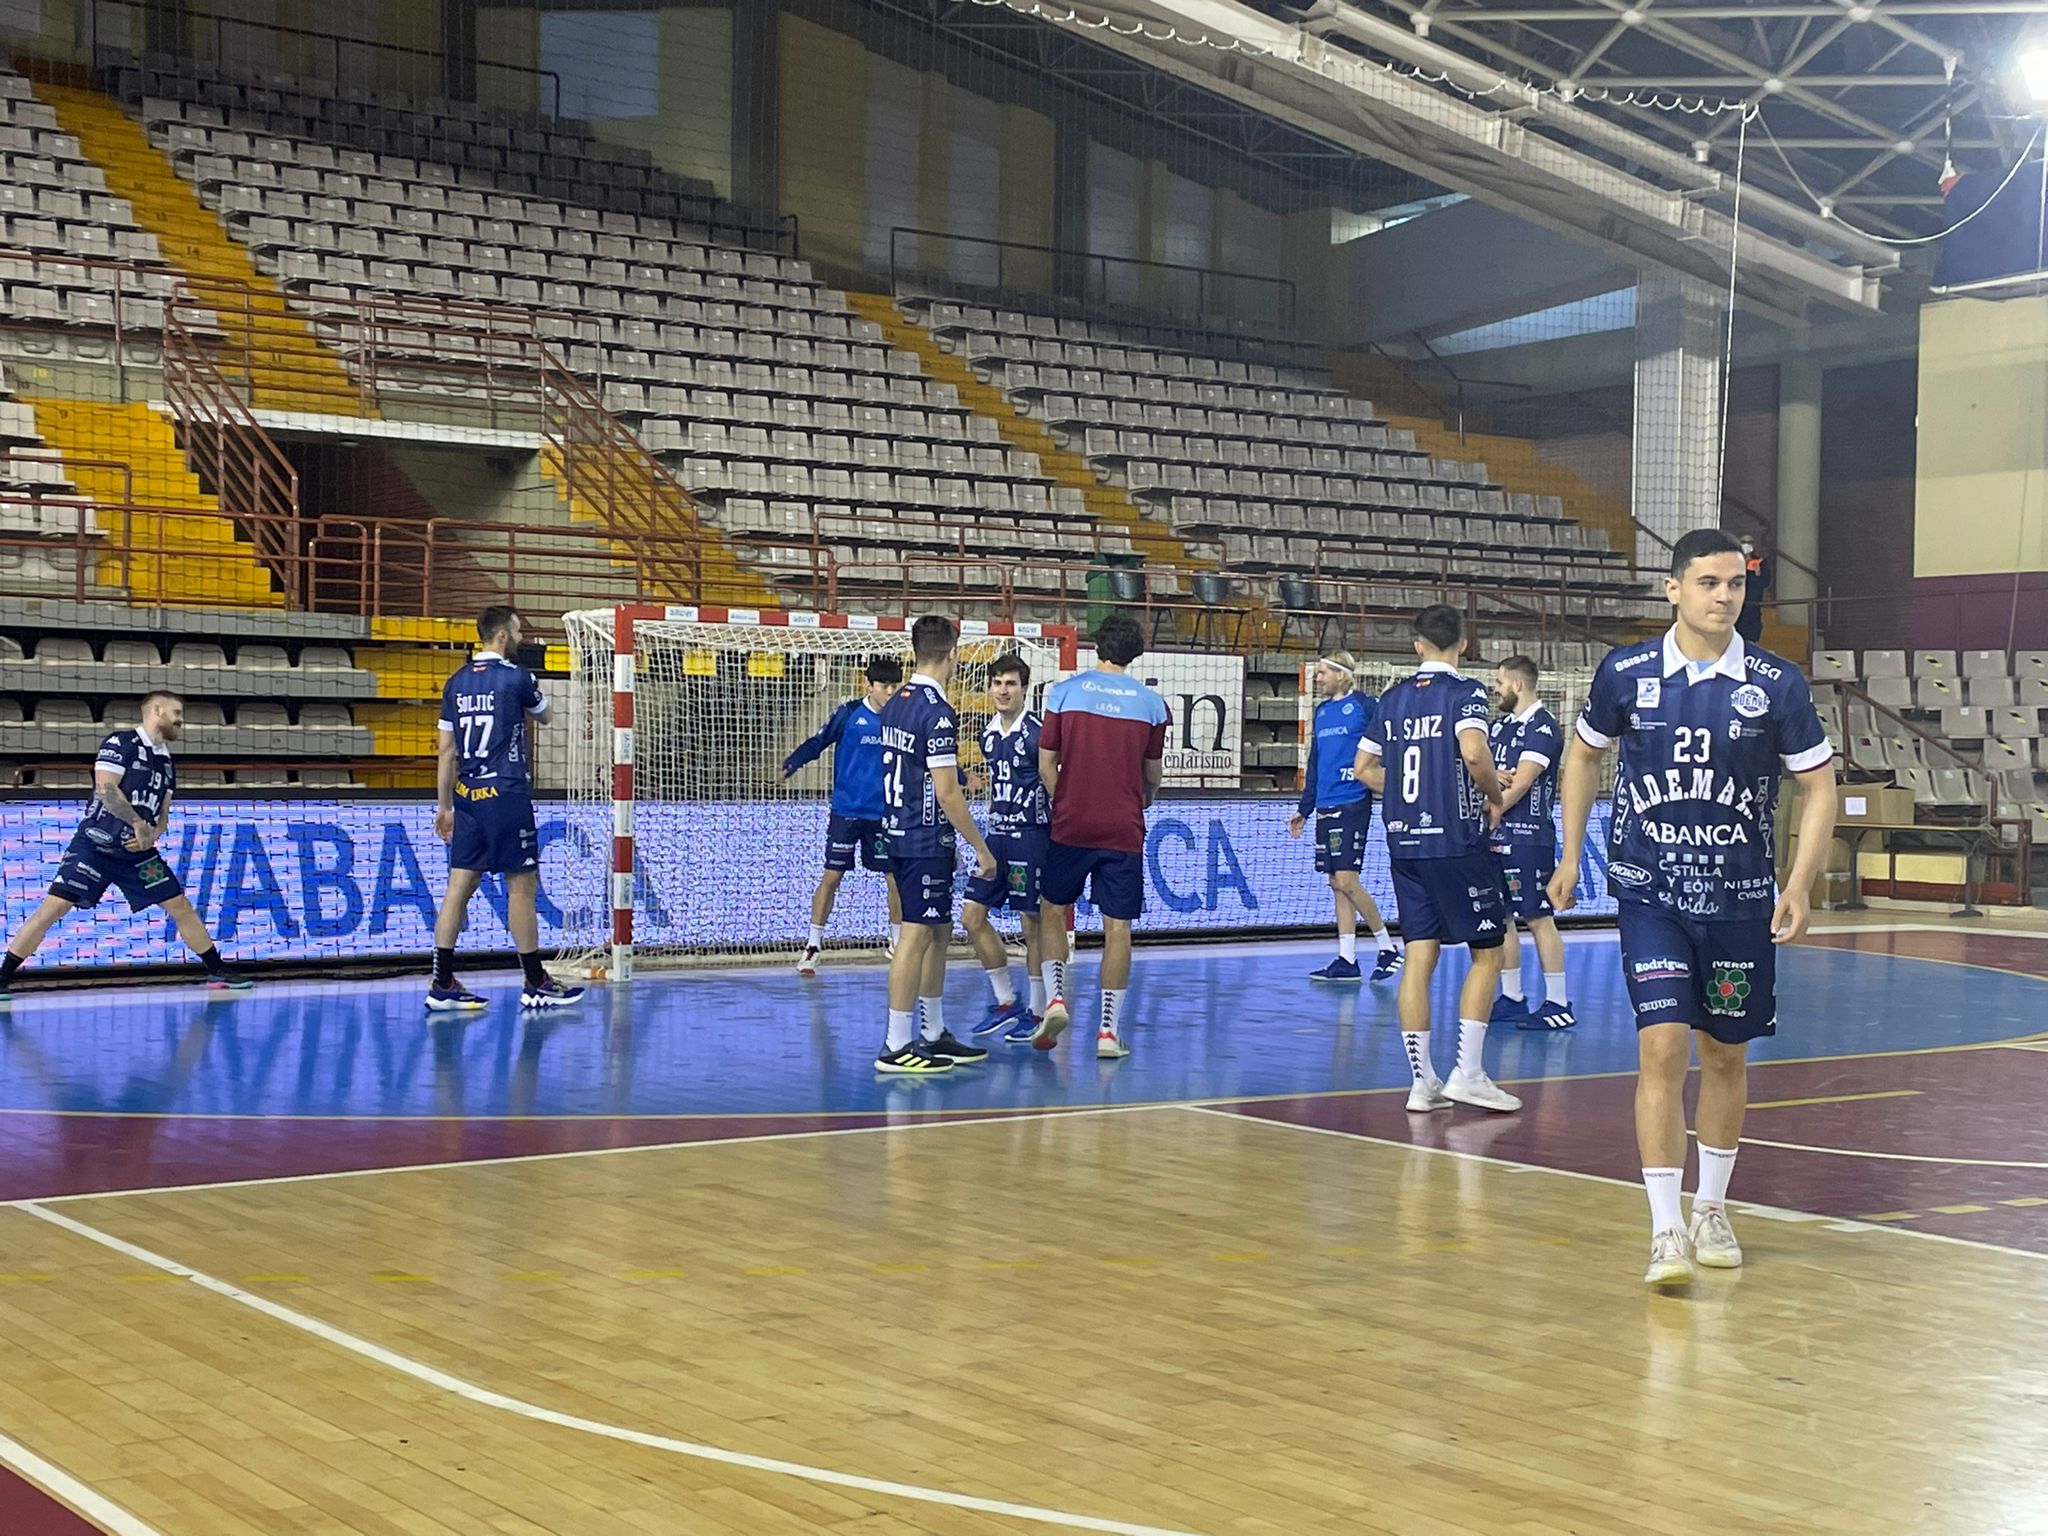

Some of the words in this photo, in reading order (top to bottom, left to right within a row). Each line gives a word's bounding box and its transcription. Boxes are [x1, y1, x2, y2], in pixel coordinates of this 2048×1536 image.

[1744, 656, 1782, 680] alsa
[1096, 703, 1120, 713] LEÓN
[459, 715, 494, 759] 77
[1404, 715, 1442, 740] SANZ
[1674, 726, 1711, 763] 23
[997, 759, 1011, 780] 19
[1164, 752, 1232, 769] entarismo
[1340, 768, 1354, 781] 75
[1403, 745, 1421, 803] 8
[1505, 822, 1540, 830] NISSAN
[1644, 821, 1748, 846] ABANCA
[1659, 859, 1722, 877] CSTILLA
[1667, 875, 1676, 888] Y
[1683, 878, 1714, 892] EÓN
[1677, 893, 1719, 914] vida
[1712, 961, 1755, 969] IVEROS
